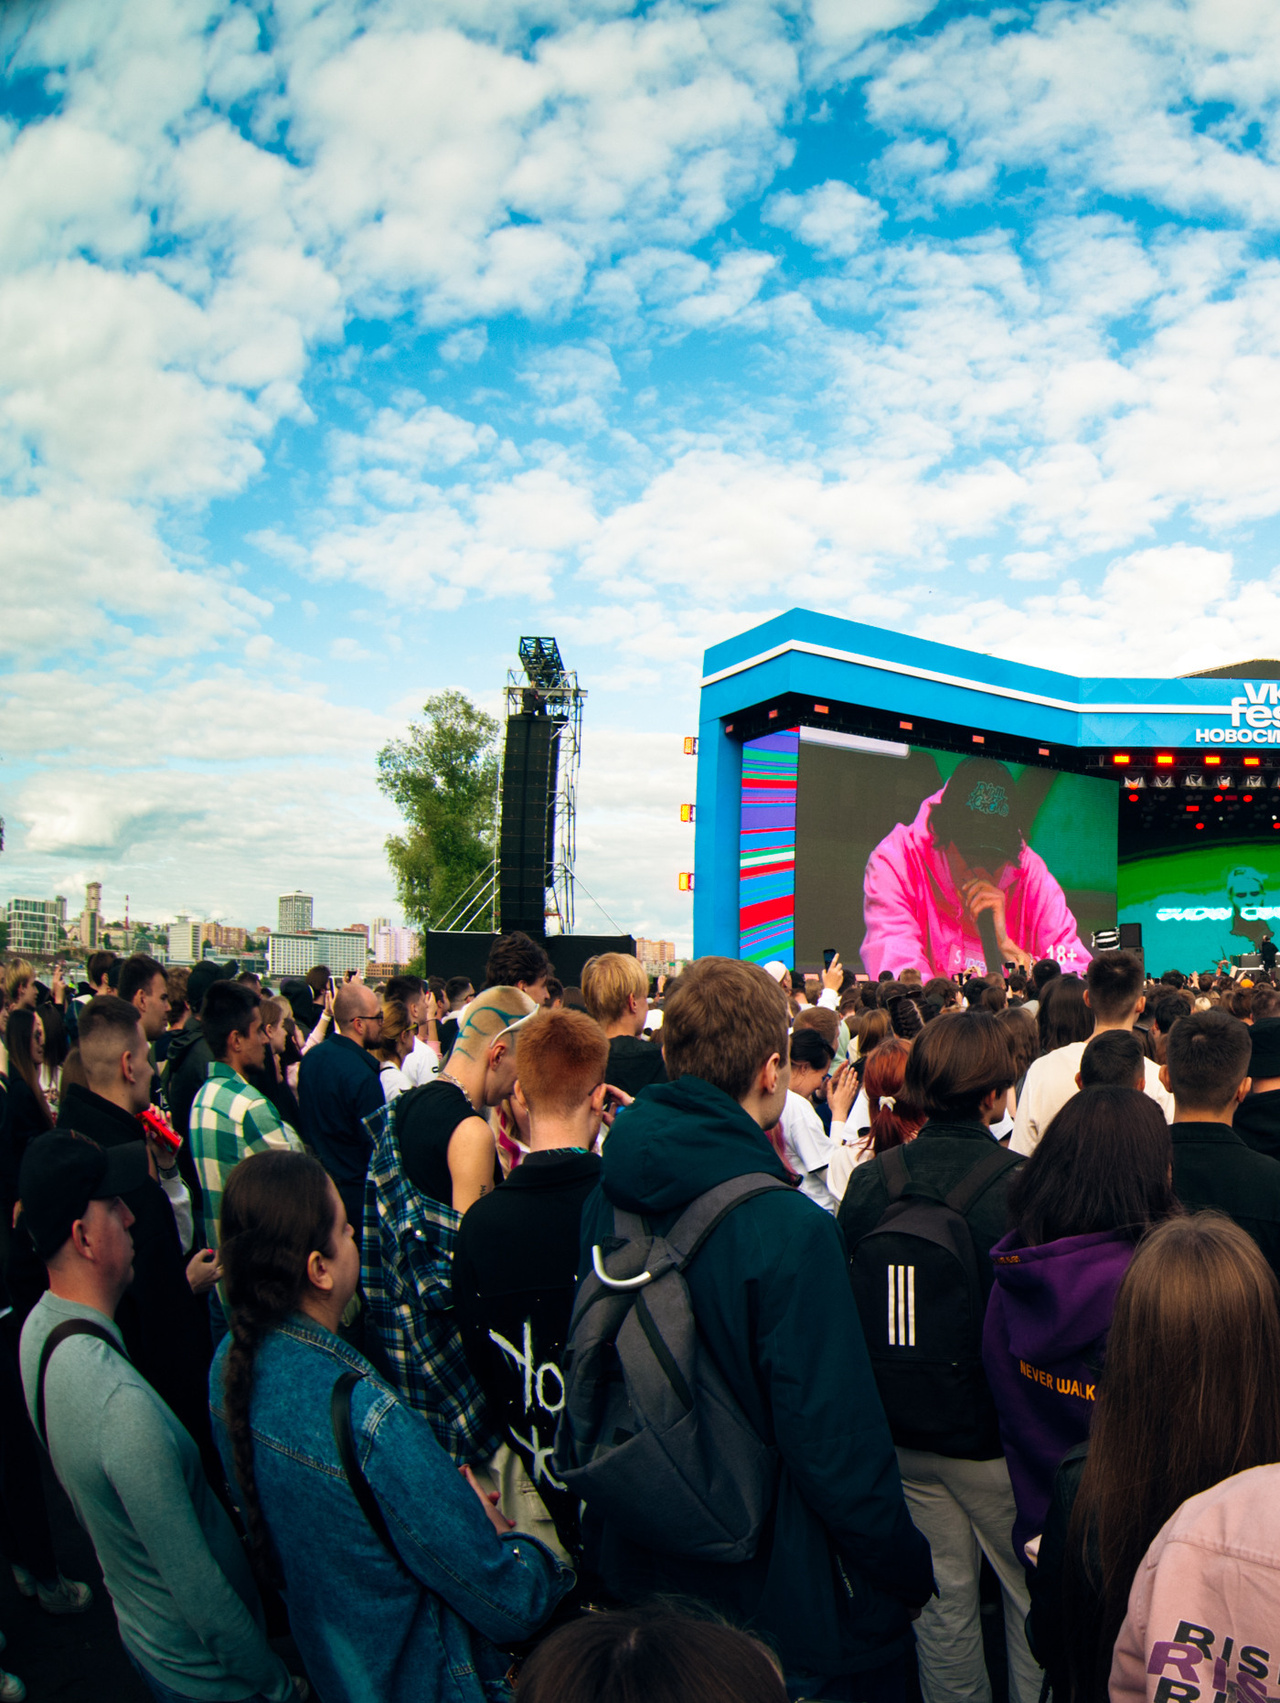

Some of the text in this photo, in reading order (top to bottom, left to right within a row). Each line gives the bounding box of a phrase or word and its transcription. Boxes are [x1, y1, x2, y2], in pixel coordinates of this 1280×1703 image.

[1046, 944, 1077, 965] 18+
[1020, 1360, 1096, 1401] NEVER WALK
